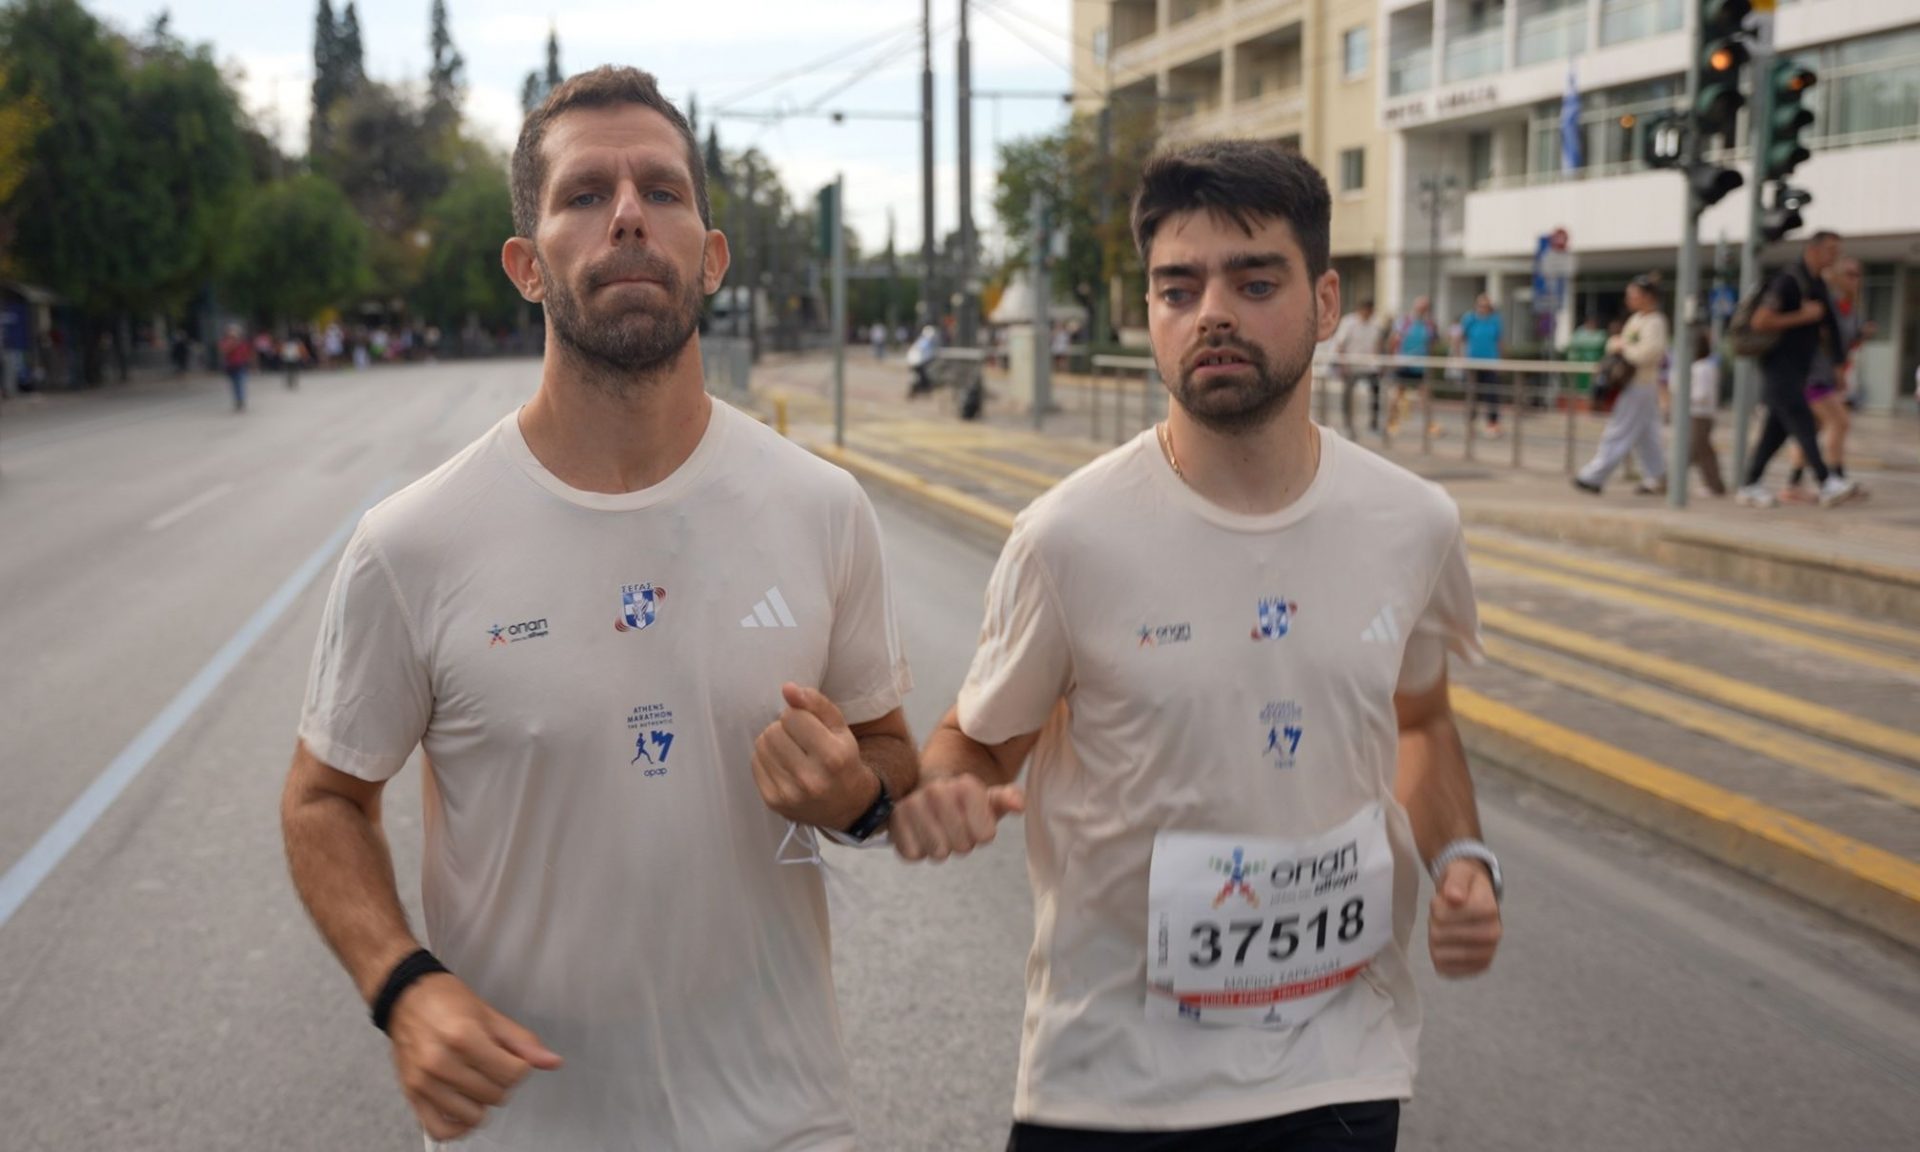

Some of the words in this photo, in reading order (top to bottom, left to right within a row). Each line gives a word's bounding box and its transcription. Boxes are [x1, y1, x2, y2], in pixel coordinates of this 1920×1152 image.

[633, 703, 664, 714] ATHENS
[627, 711, 673, 723] MARATHON
[1188, 894, 1365, 970] 37518
